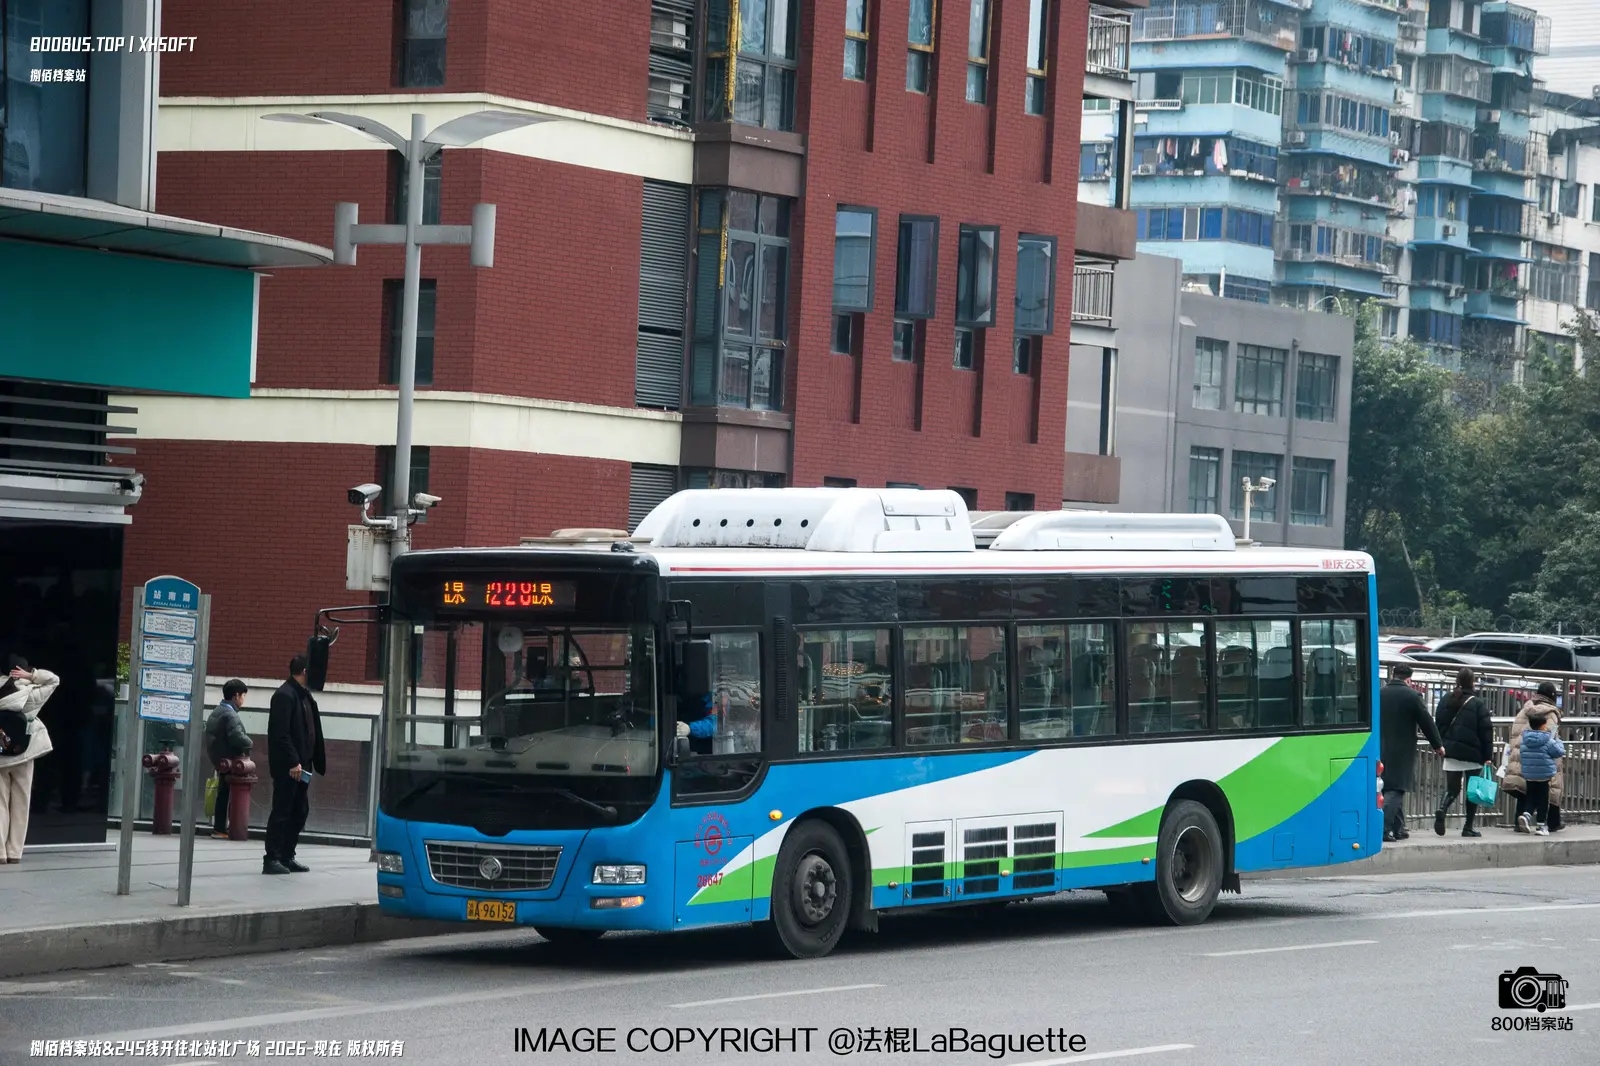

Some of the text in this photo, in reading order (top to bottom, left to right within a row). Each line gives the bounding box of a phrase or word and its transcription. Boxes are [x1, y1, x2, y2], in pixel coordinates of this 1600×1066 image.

[1322, 559, 1366, 570] 重庆公交
[697, 873, 723, 888] 26647
